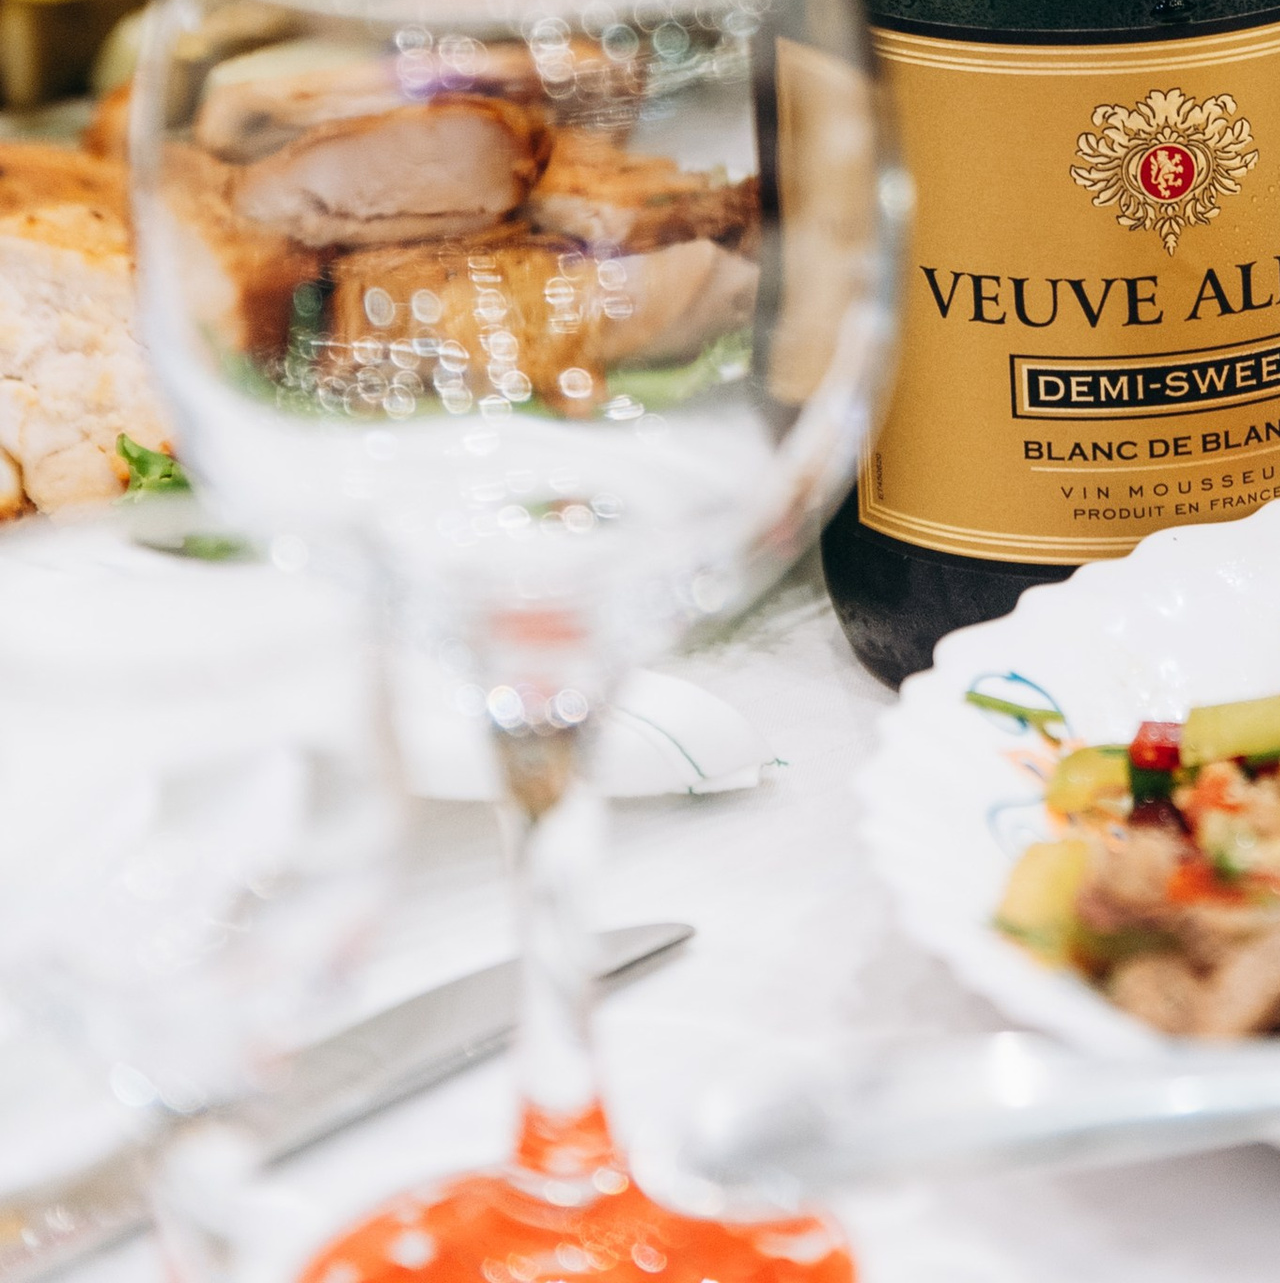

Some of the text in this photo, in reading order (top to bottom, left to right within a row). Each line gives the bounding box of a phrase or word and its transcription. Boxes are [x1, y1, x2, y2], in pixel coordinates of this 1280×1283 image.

[919, 265, 1165, 329] VEUVE
[1023, 439, 1138, 462] BLANC
[1148, 435, 1193, 459] DE
[1060, 485, 1111, 499] VIN
[1073, 505, 1166, 521] PRODUIT
[1174, 502, 1201, 516] EN
